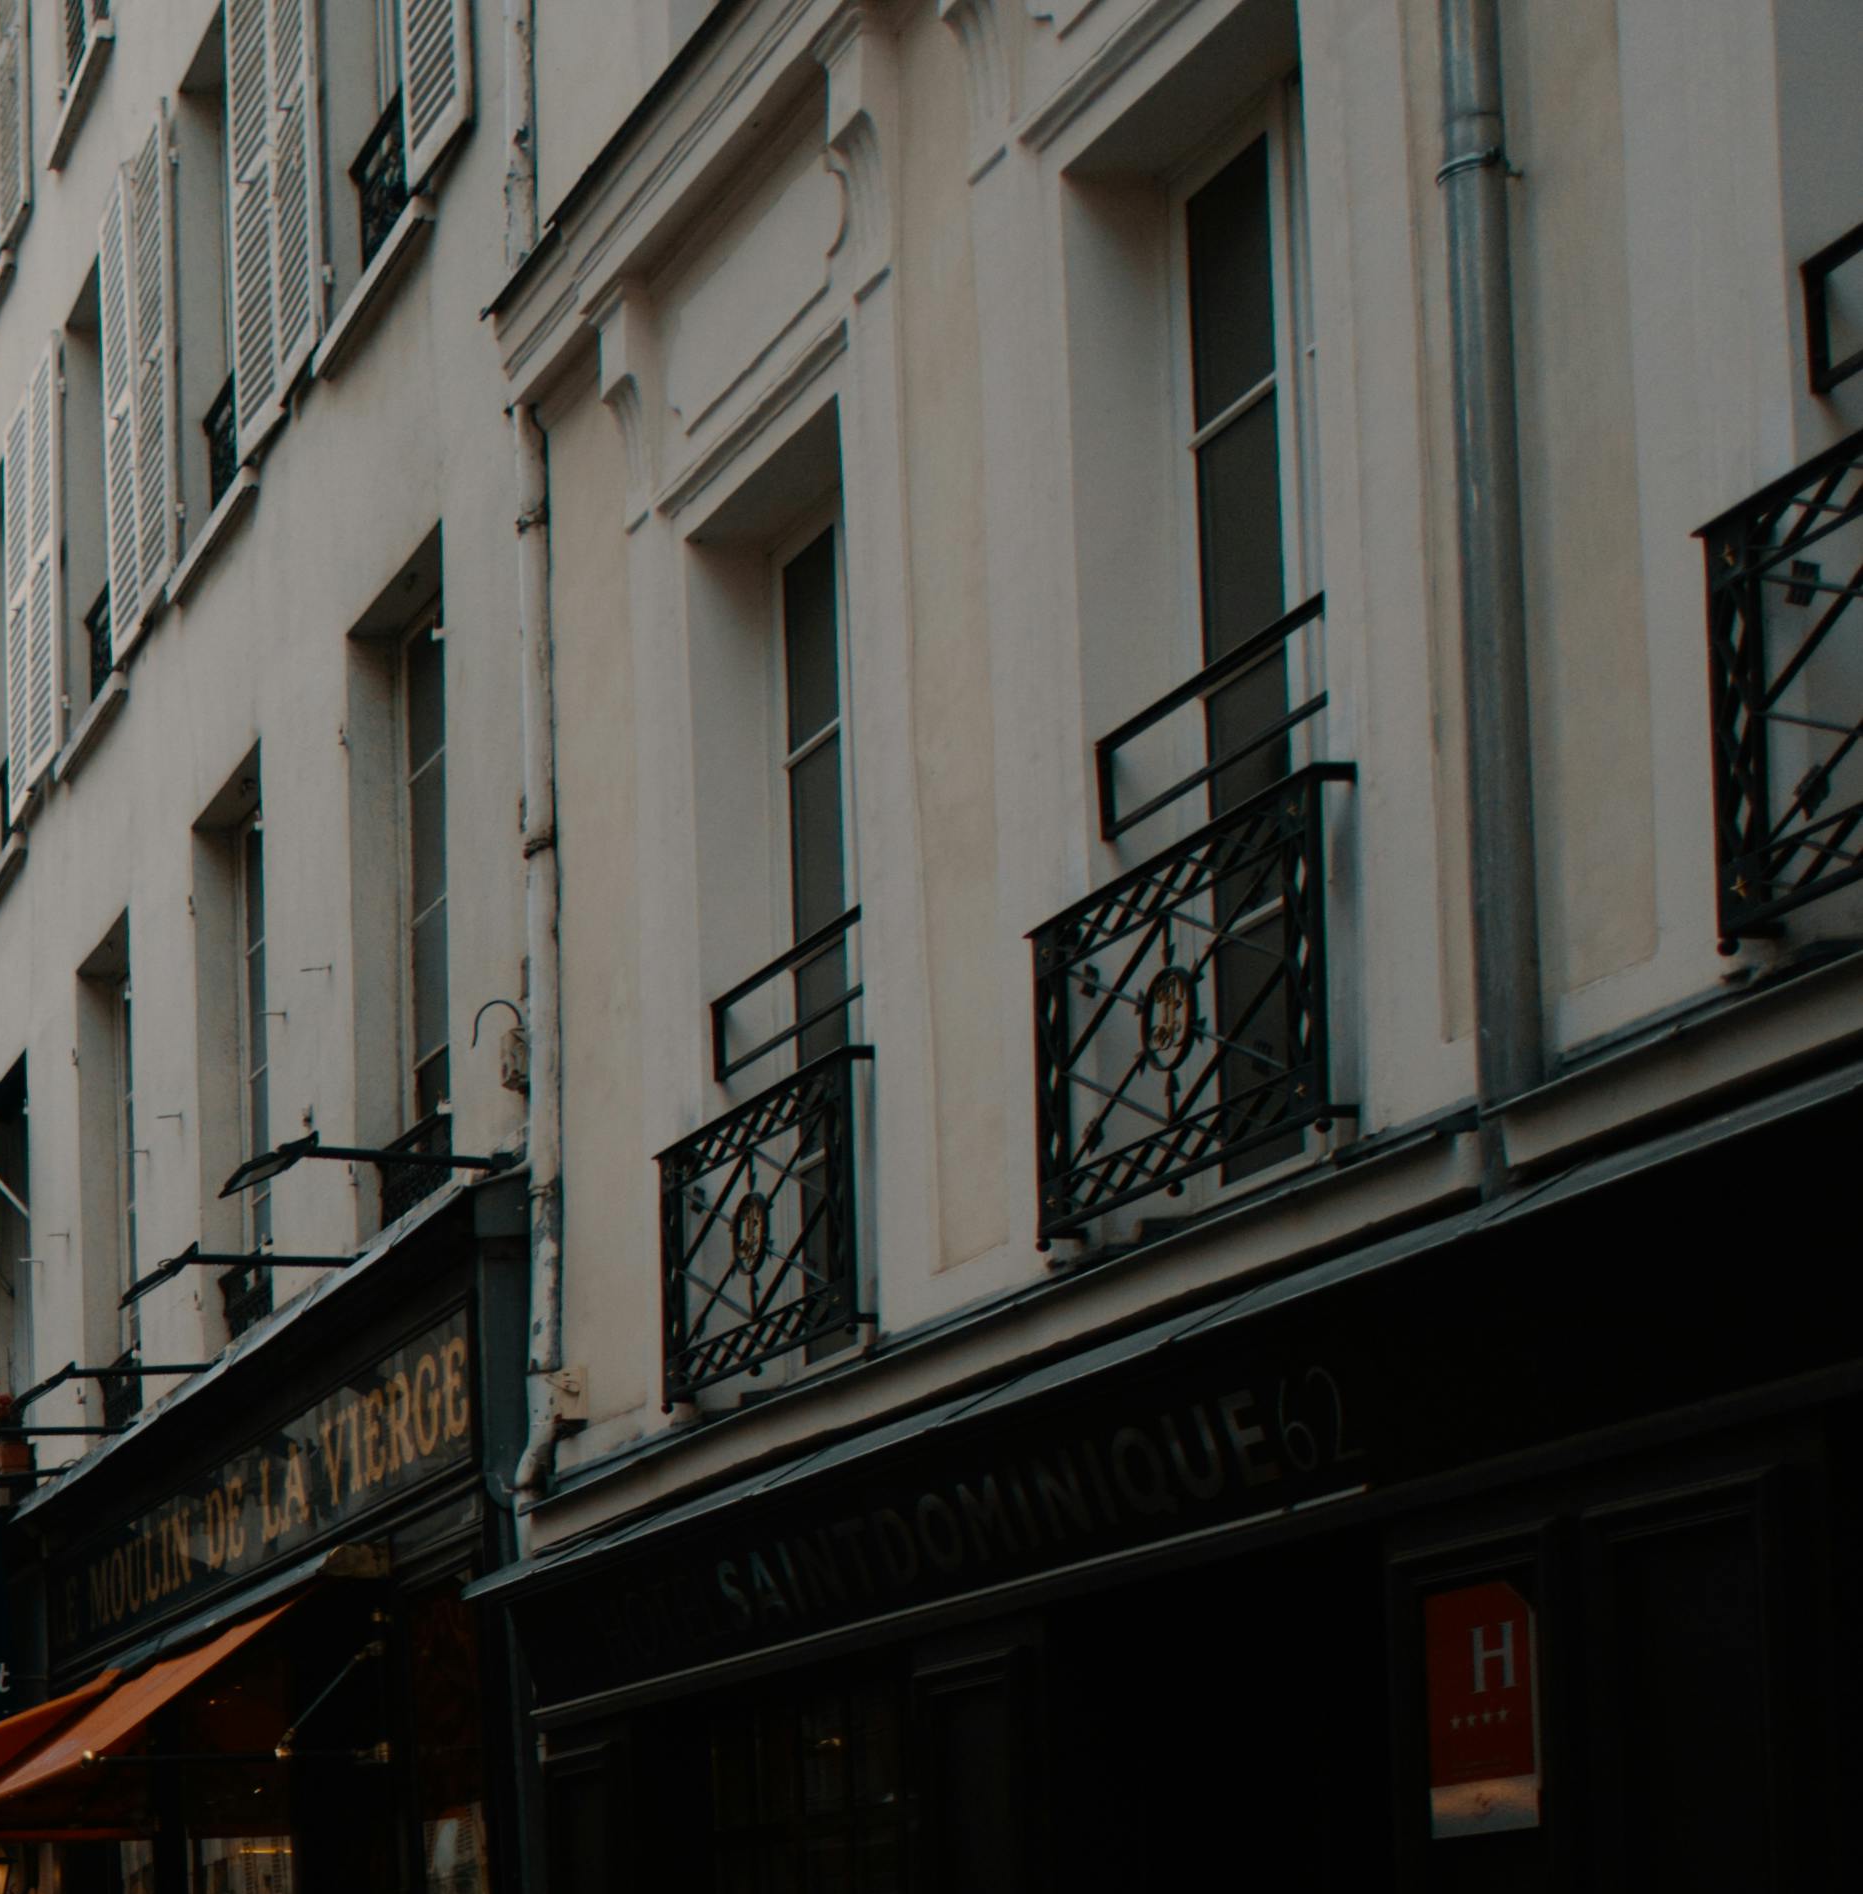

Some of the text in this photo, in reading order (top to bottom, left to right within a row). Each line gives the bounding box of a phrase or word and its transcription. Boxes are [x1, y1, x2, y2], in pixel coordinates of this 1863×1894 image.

[88, 1503, 193, 1632] MOULIN
[204, 1475, 246, 1572] DE
[258, 1440, 313, 1543] LA
[319, 1337, 470, 1507] VIERGE
[1468, 1619, 1519, 1695] H
